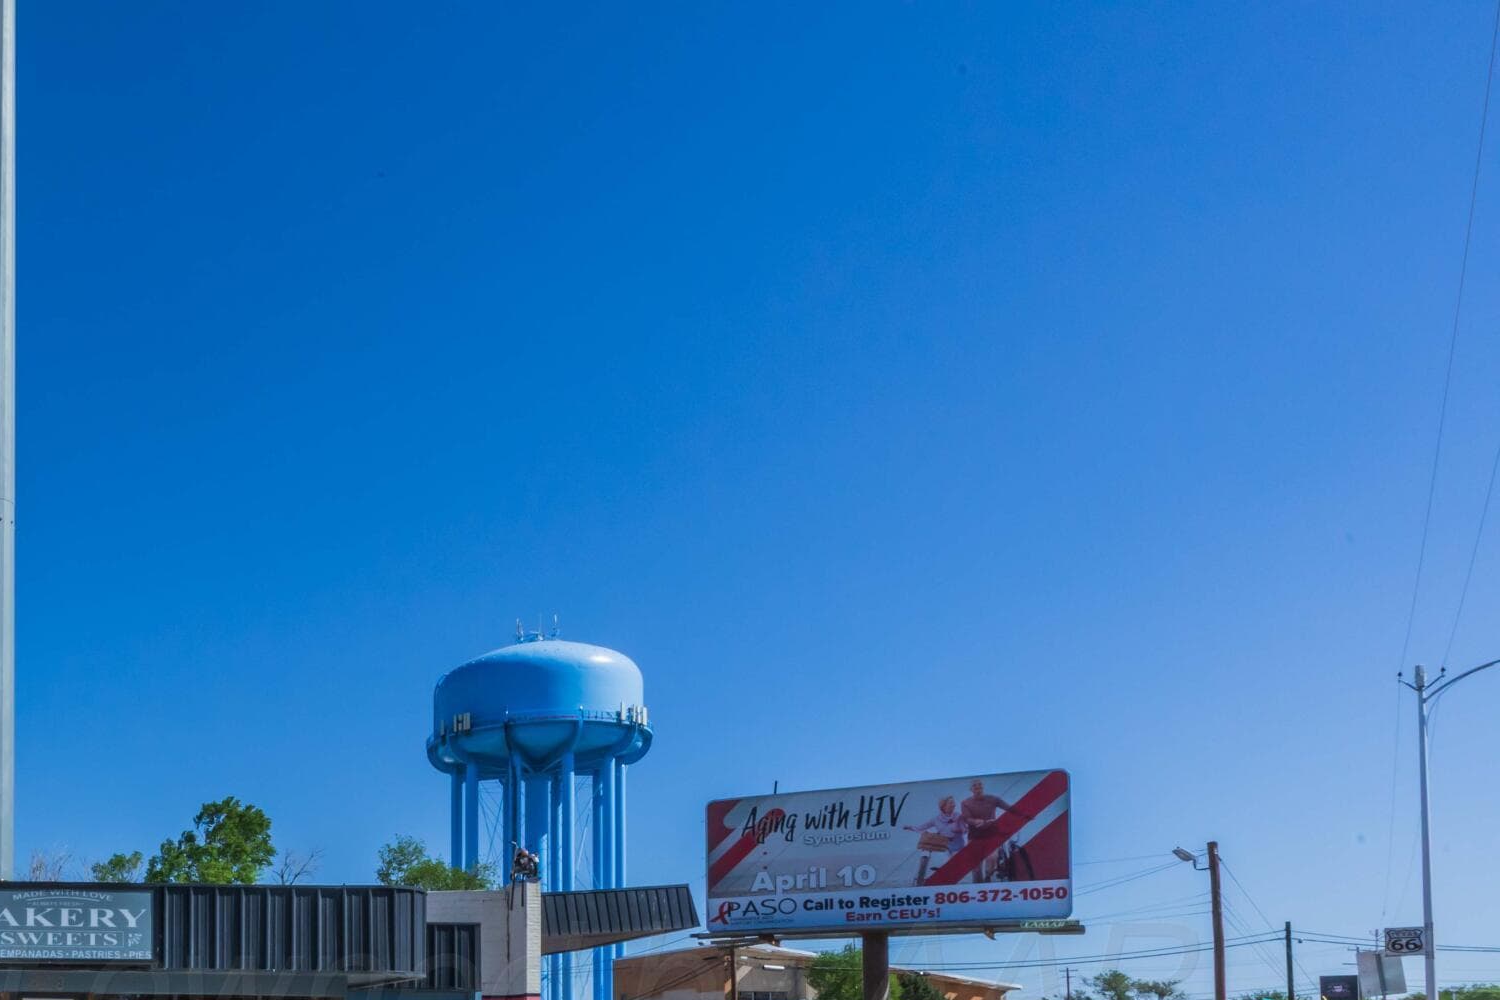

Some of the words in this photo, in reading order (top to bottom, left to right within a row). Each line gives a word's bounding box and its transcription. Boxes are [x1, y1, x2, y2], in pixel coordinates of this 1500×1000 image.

[741, 806, 797, 844] Aging
[804, 801, 849, 830] with
[853, 792, 910, 830] HIV
[804, 831, 891, 848] Symposium
[751, 866, 827, 896] April
[836, 864, 877, 887] 10
[12, 889, 47, 901] MADE
[50, 888, 79, 897] WITH
[83, 890, 114, 901] LOVE
[803, 898, 834, 911] Call
[838, 899, 854, 910] to
[859, 893, 930, 911] Register
[934, 886, 1068, 905] 806-372-1050
[727, 897, 798, 917] PASO
[846, 910, 882, 922] Earn
[887, 907, 941, 921] CEU's!
[1, 931, 118, 945] SWEETS
[1390, 938, 1418, 951] 66
[1, 949, 63, 959] EMPANADAS
[72, 950, 120, 959] PASTRIES
[129, 950, 152, 959] PIES
